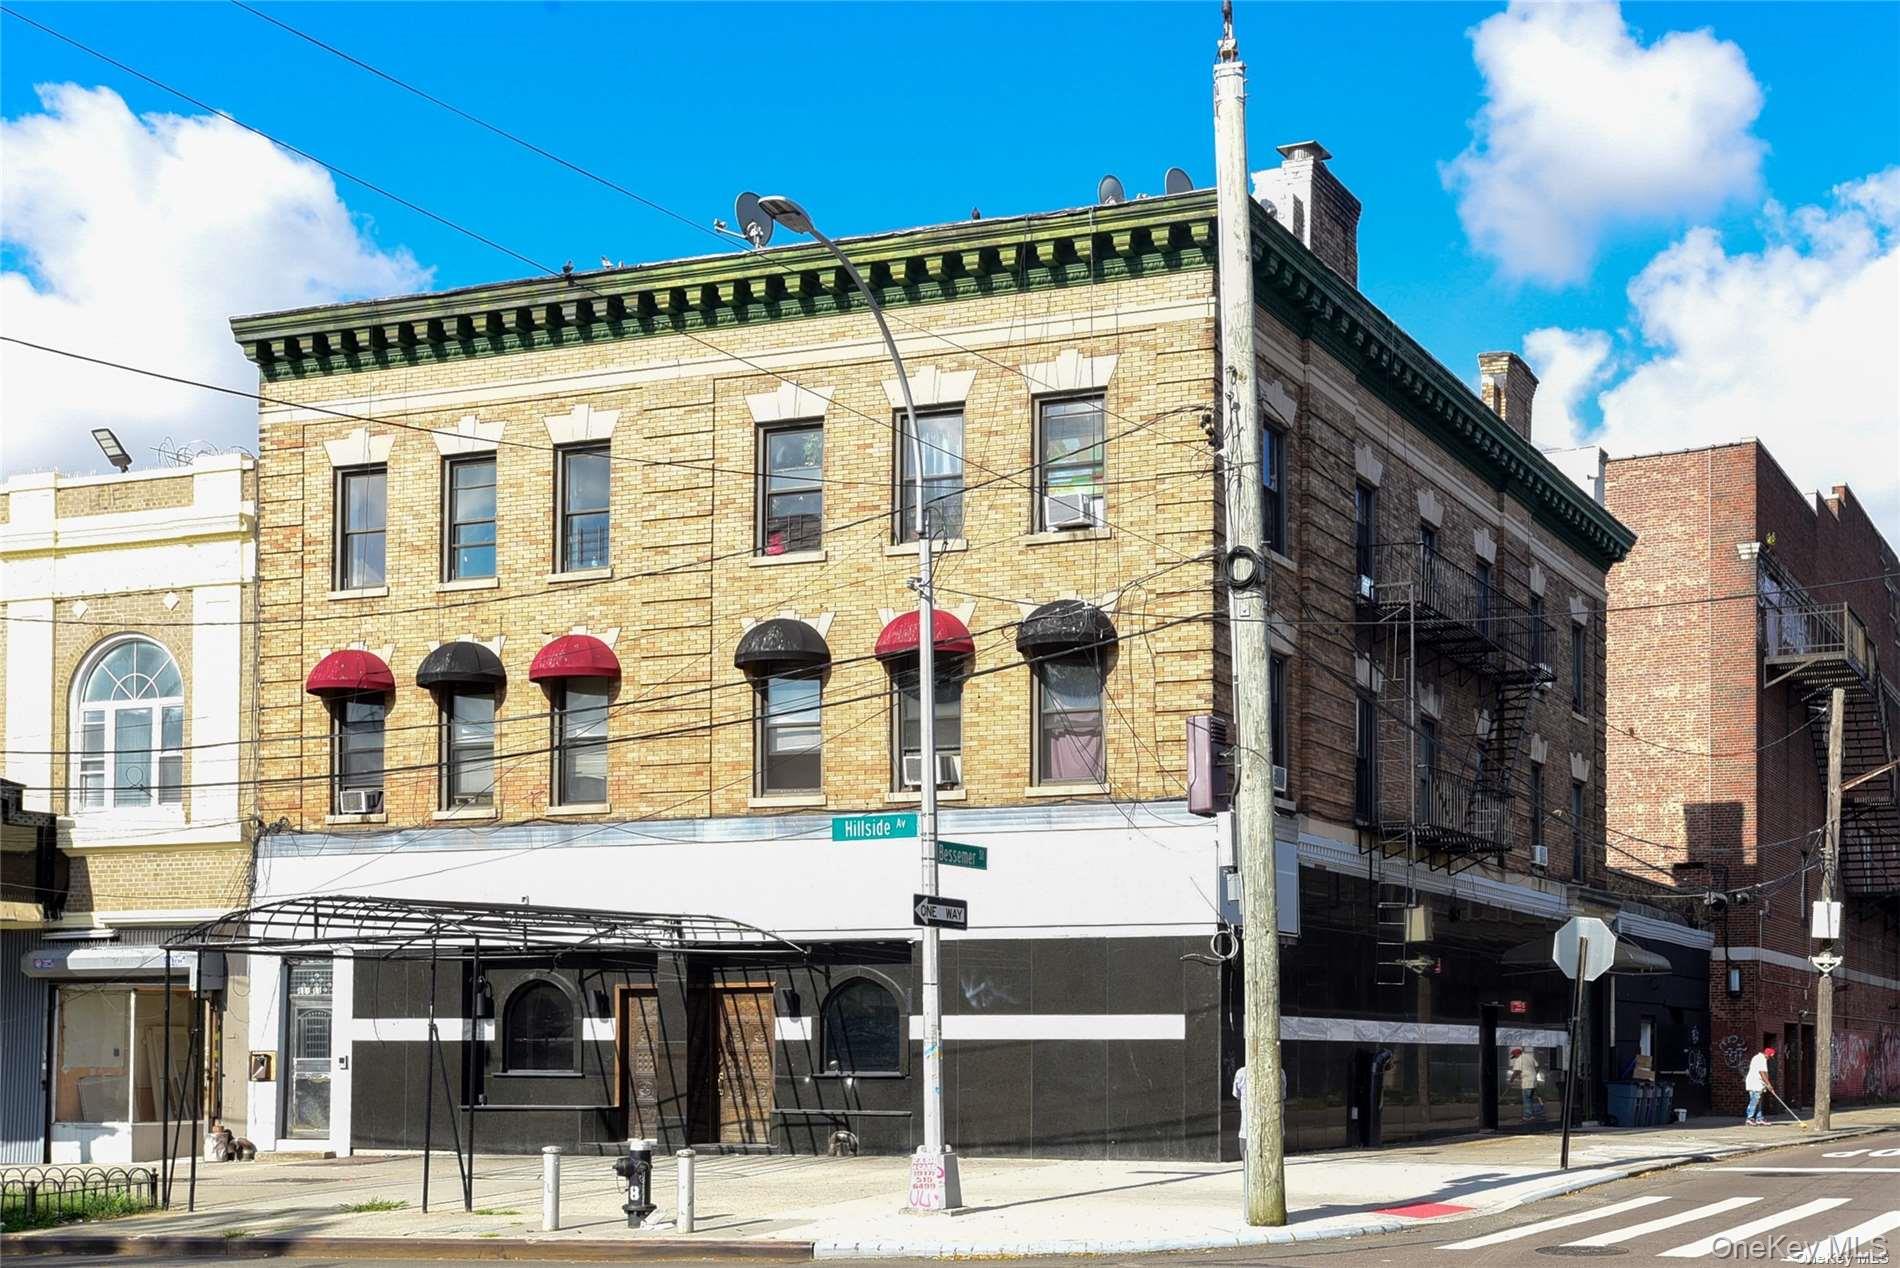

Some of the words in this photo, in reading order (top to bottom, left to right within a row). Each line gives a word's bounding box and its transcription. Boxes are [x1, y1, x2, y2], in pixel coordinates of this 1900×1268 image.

[845, 820, 891, 837] Hillside
[896, 818, 906, 829] Av
[939, 844, 976, 865] Bessemer
[920, 904, 938, 918] ONE
[945, 907, 963, 920] WAY
